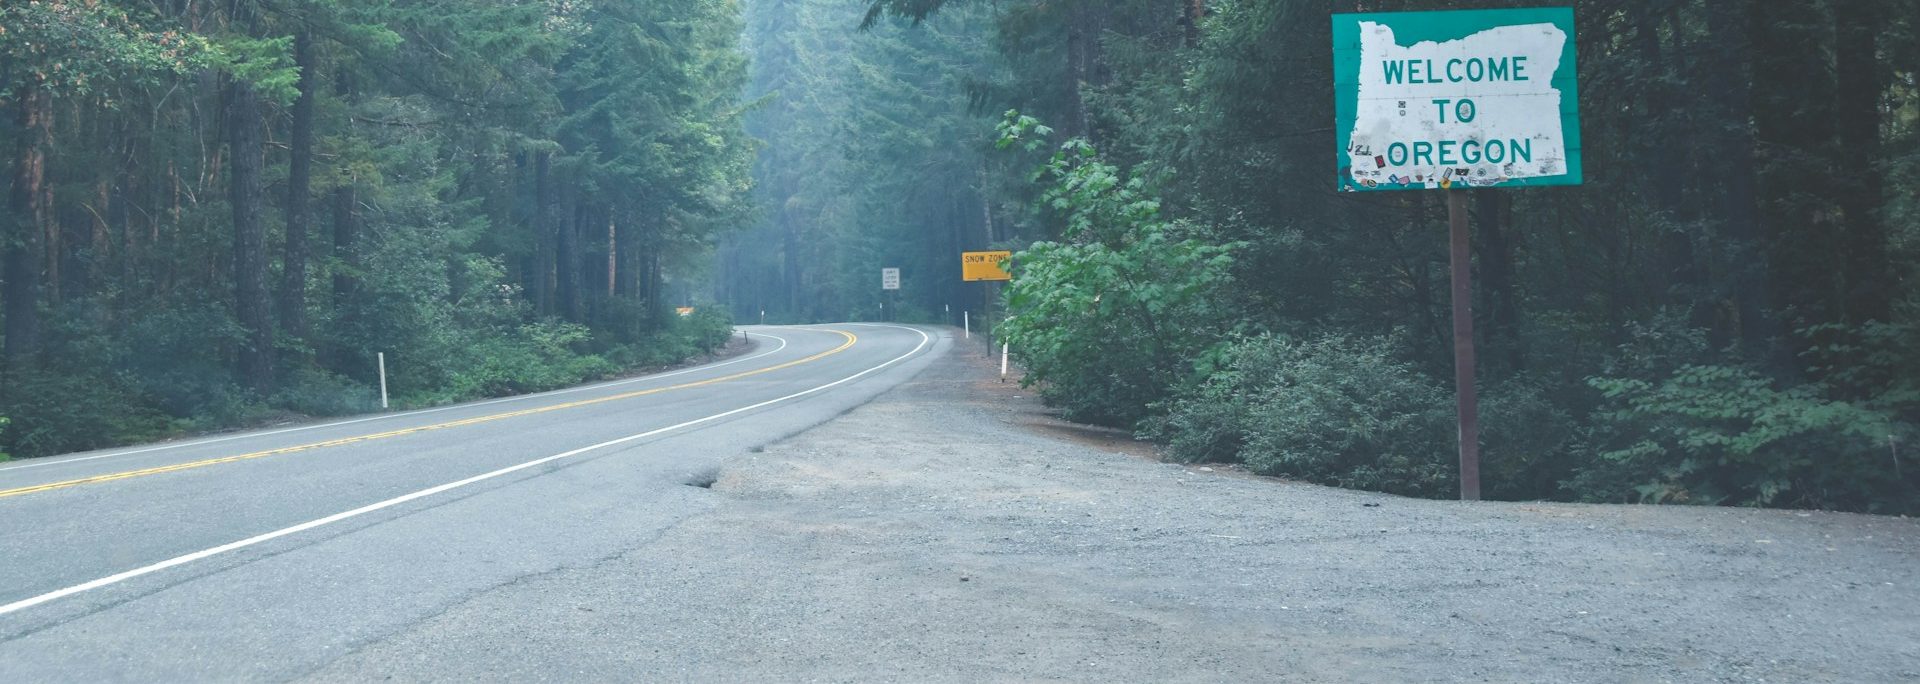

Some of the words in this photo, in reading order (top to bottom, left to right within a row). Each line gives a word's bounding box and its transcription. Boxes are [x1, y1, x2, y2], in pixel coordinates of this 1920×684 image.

[1382, 56, 1529, 84] WELCOME
[1432, 98, 1476, 124] TO
[1387, 138, 1532, 166] OREGON
[965, 255, 985, 263] SNOW
